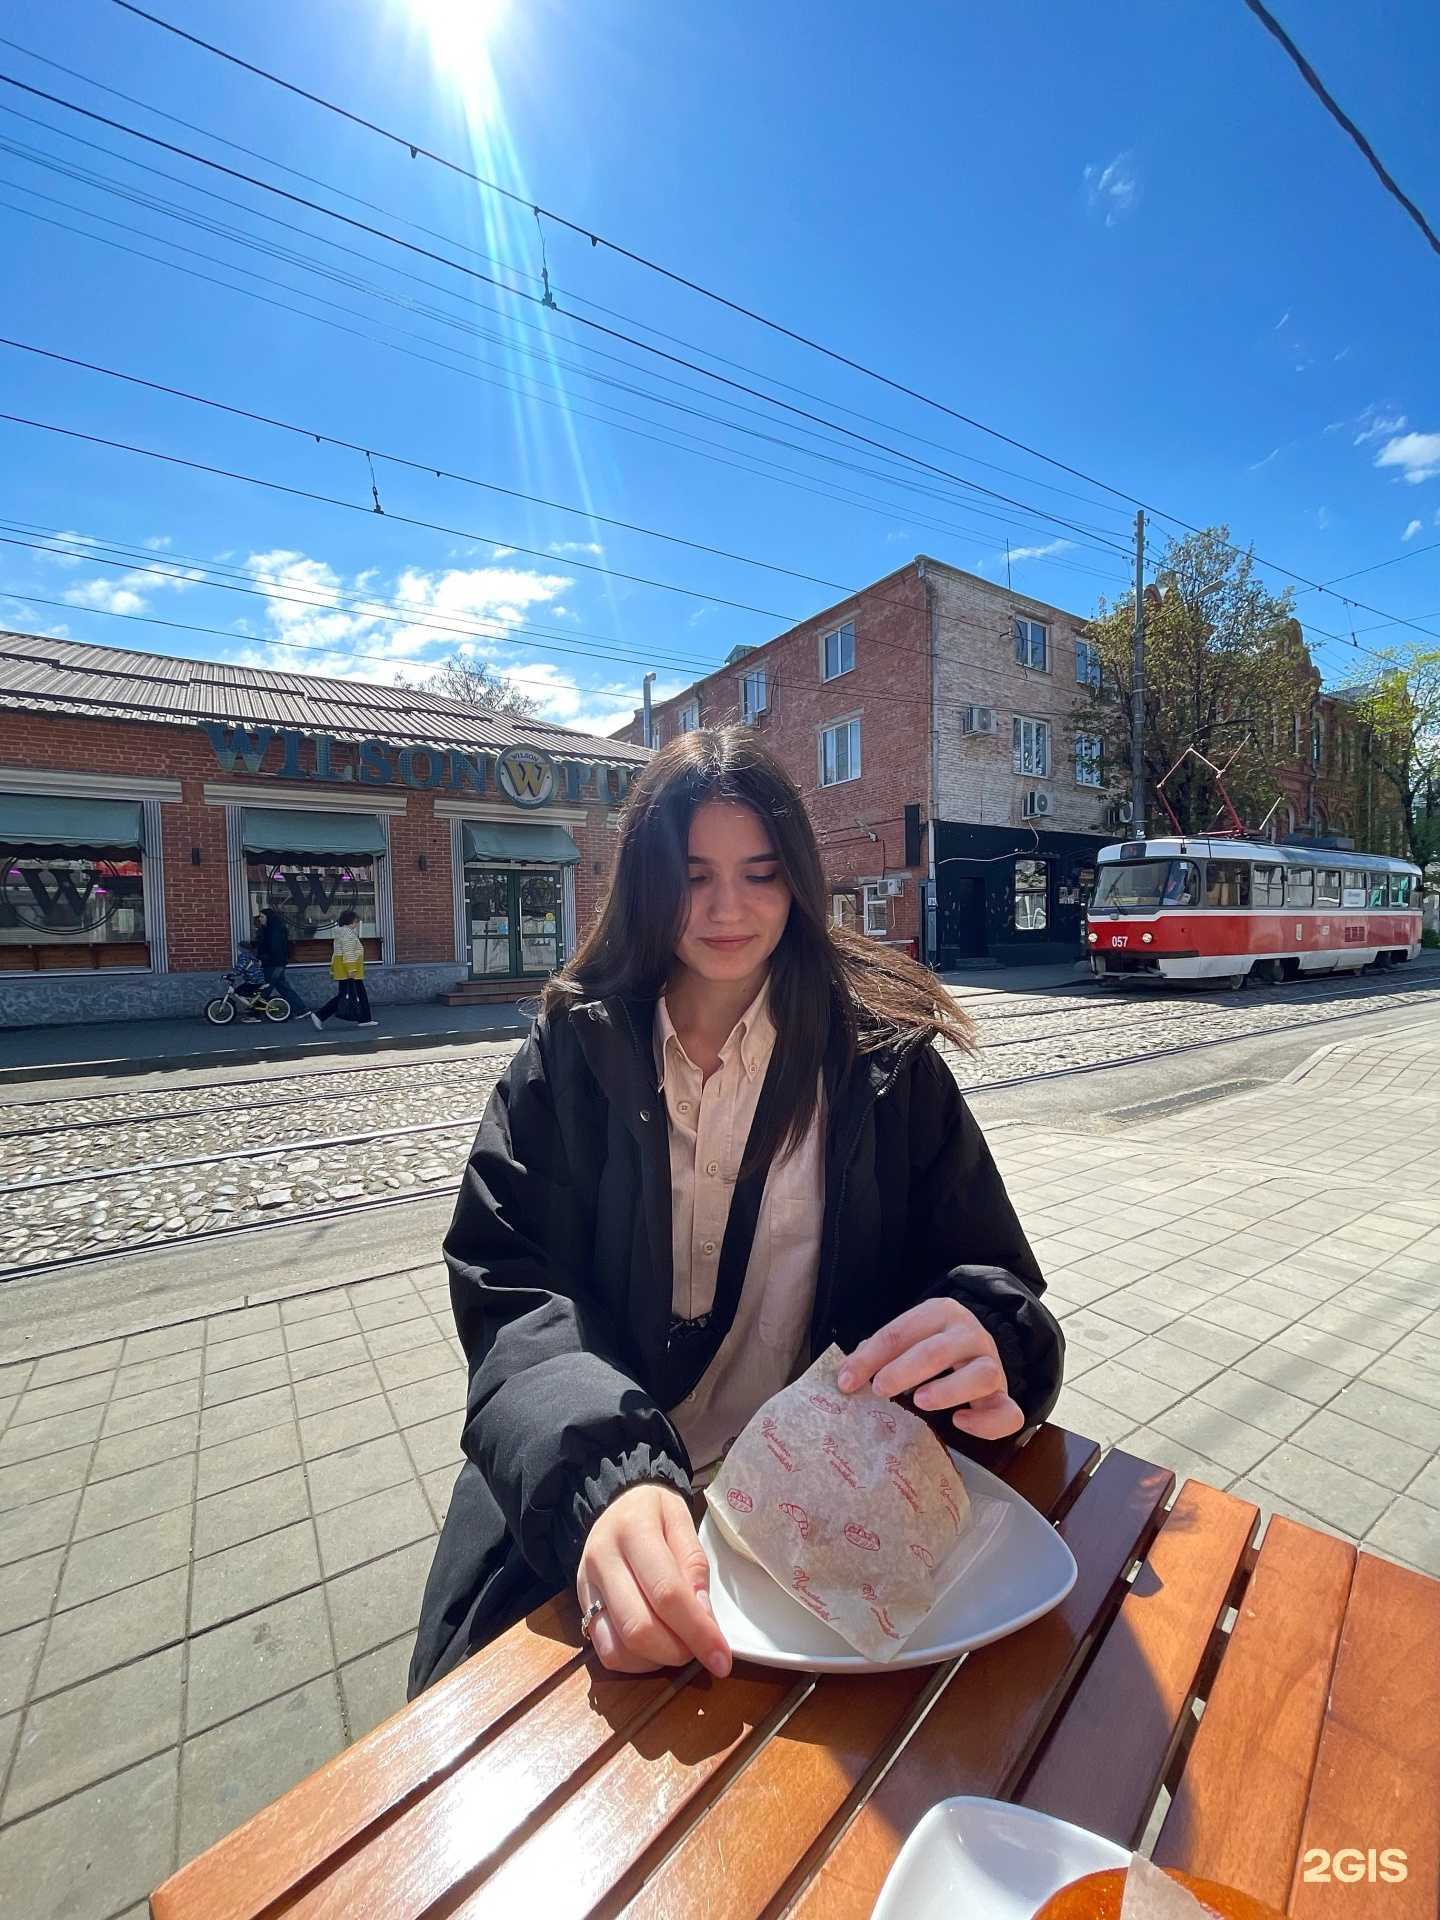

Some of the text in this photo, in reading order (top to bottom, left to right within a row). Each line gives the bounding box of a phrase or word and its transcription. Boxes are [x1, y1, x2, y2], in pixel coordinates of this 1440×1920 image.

[199, 720, 641, 804] WILSON PU
[502, 759, 550, 798] W
[20, 868, 100, 916] W
[281, 871, 345, 914] W
[1111, 935, 1129, 948] 057
